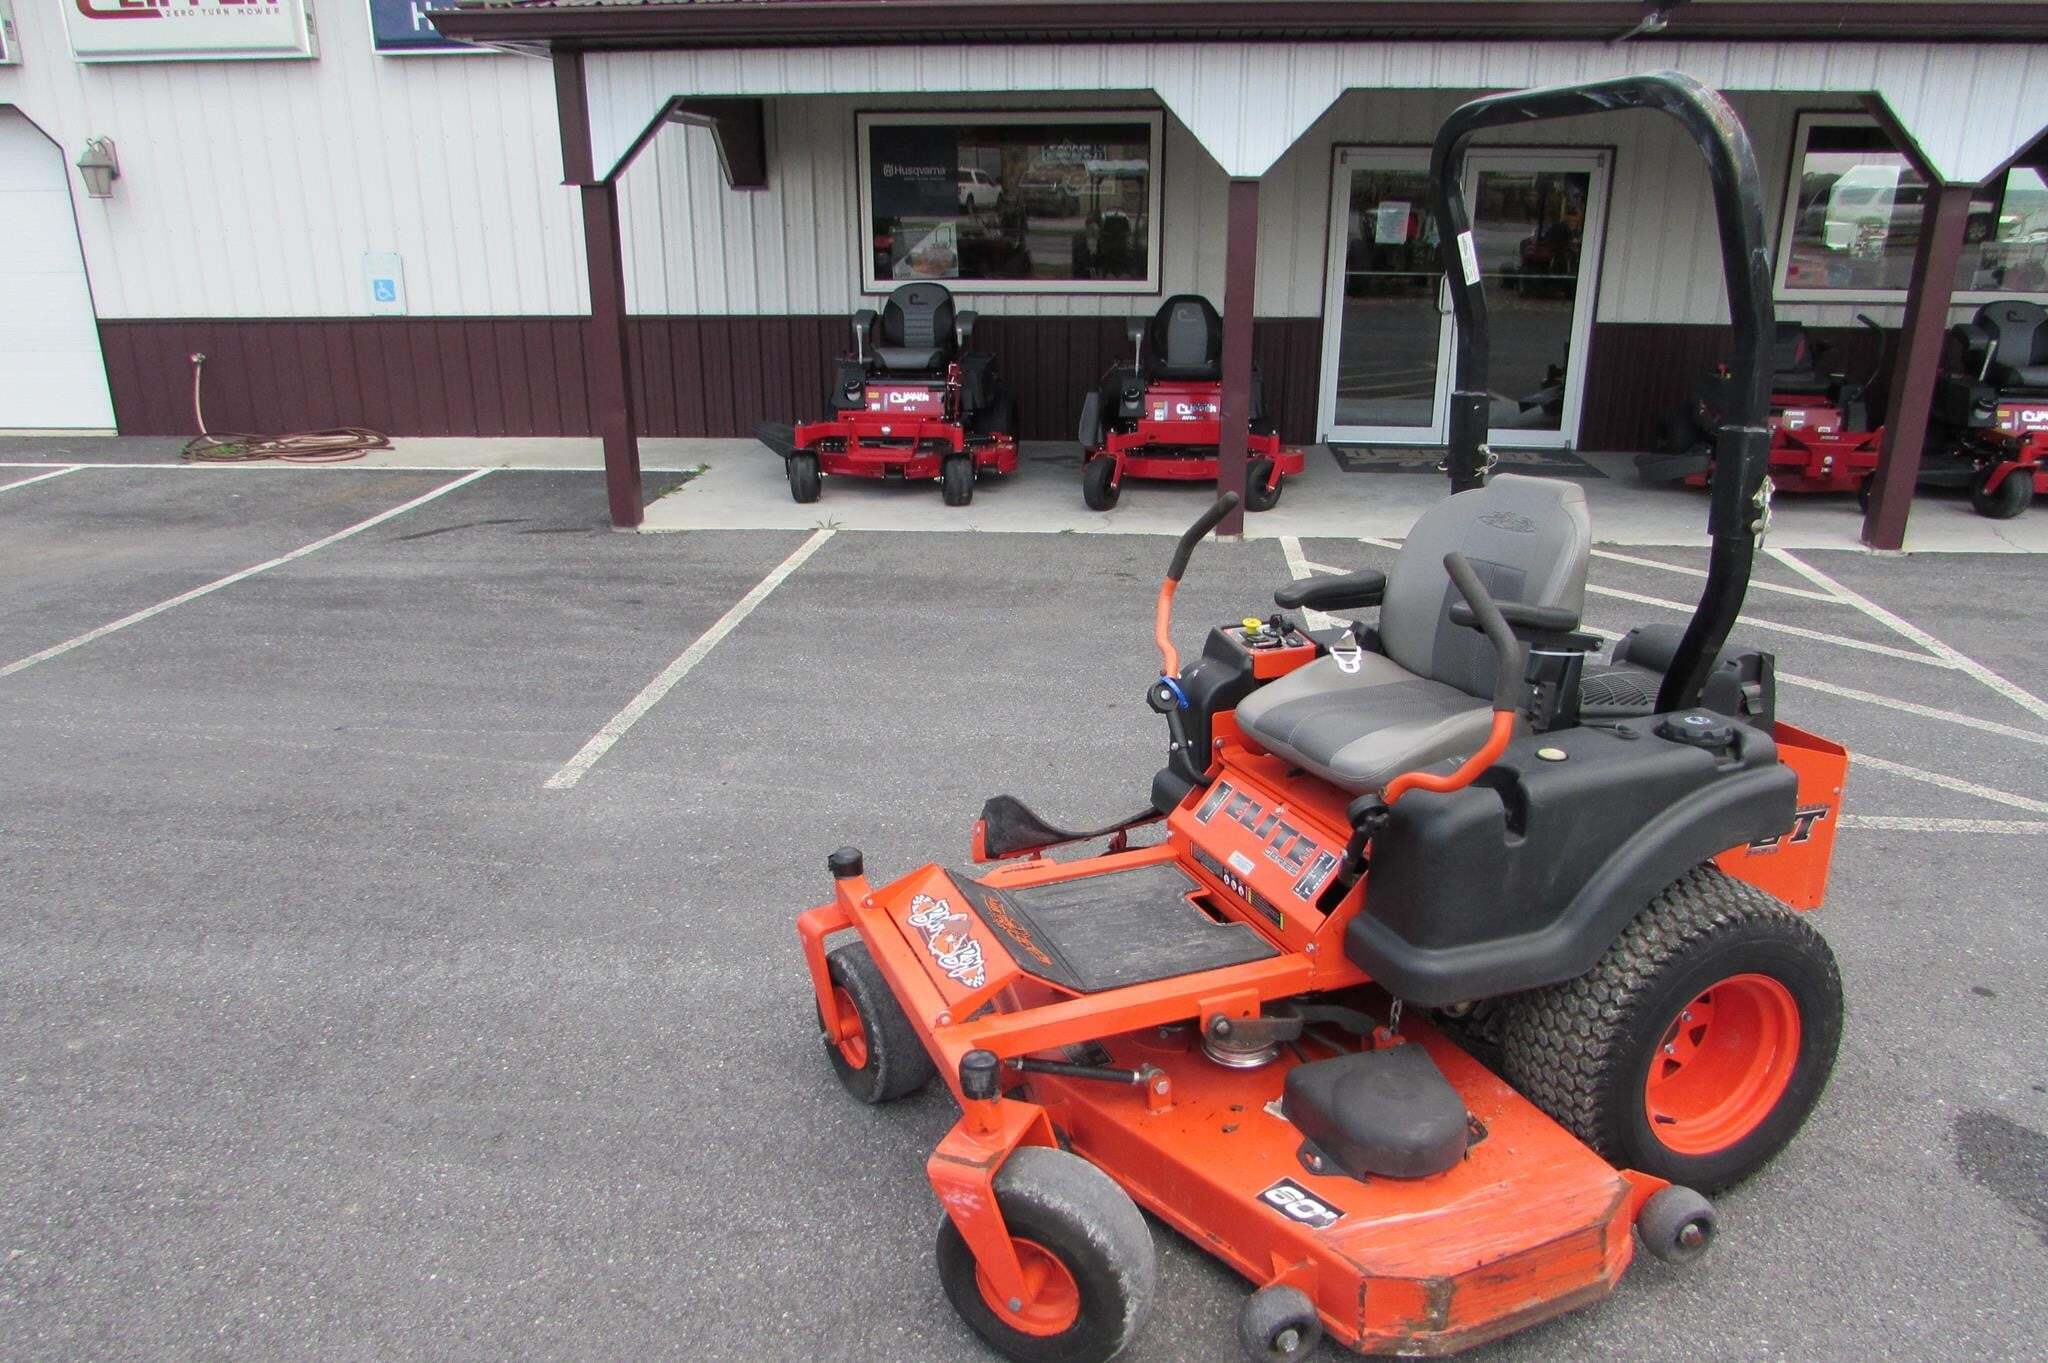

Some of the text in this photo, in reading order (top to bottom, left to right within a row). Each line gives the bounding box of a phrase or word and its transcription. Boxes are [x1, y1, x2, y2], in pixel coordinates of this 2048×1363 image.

[166, 8, 194, 17] ZERO
[202, 8, 230, 16] TURN
[238, 7, 280, 16] MOWER
[1224, 791, 1318, 867] ELITE
